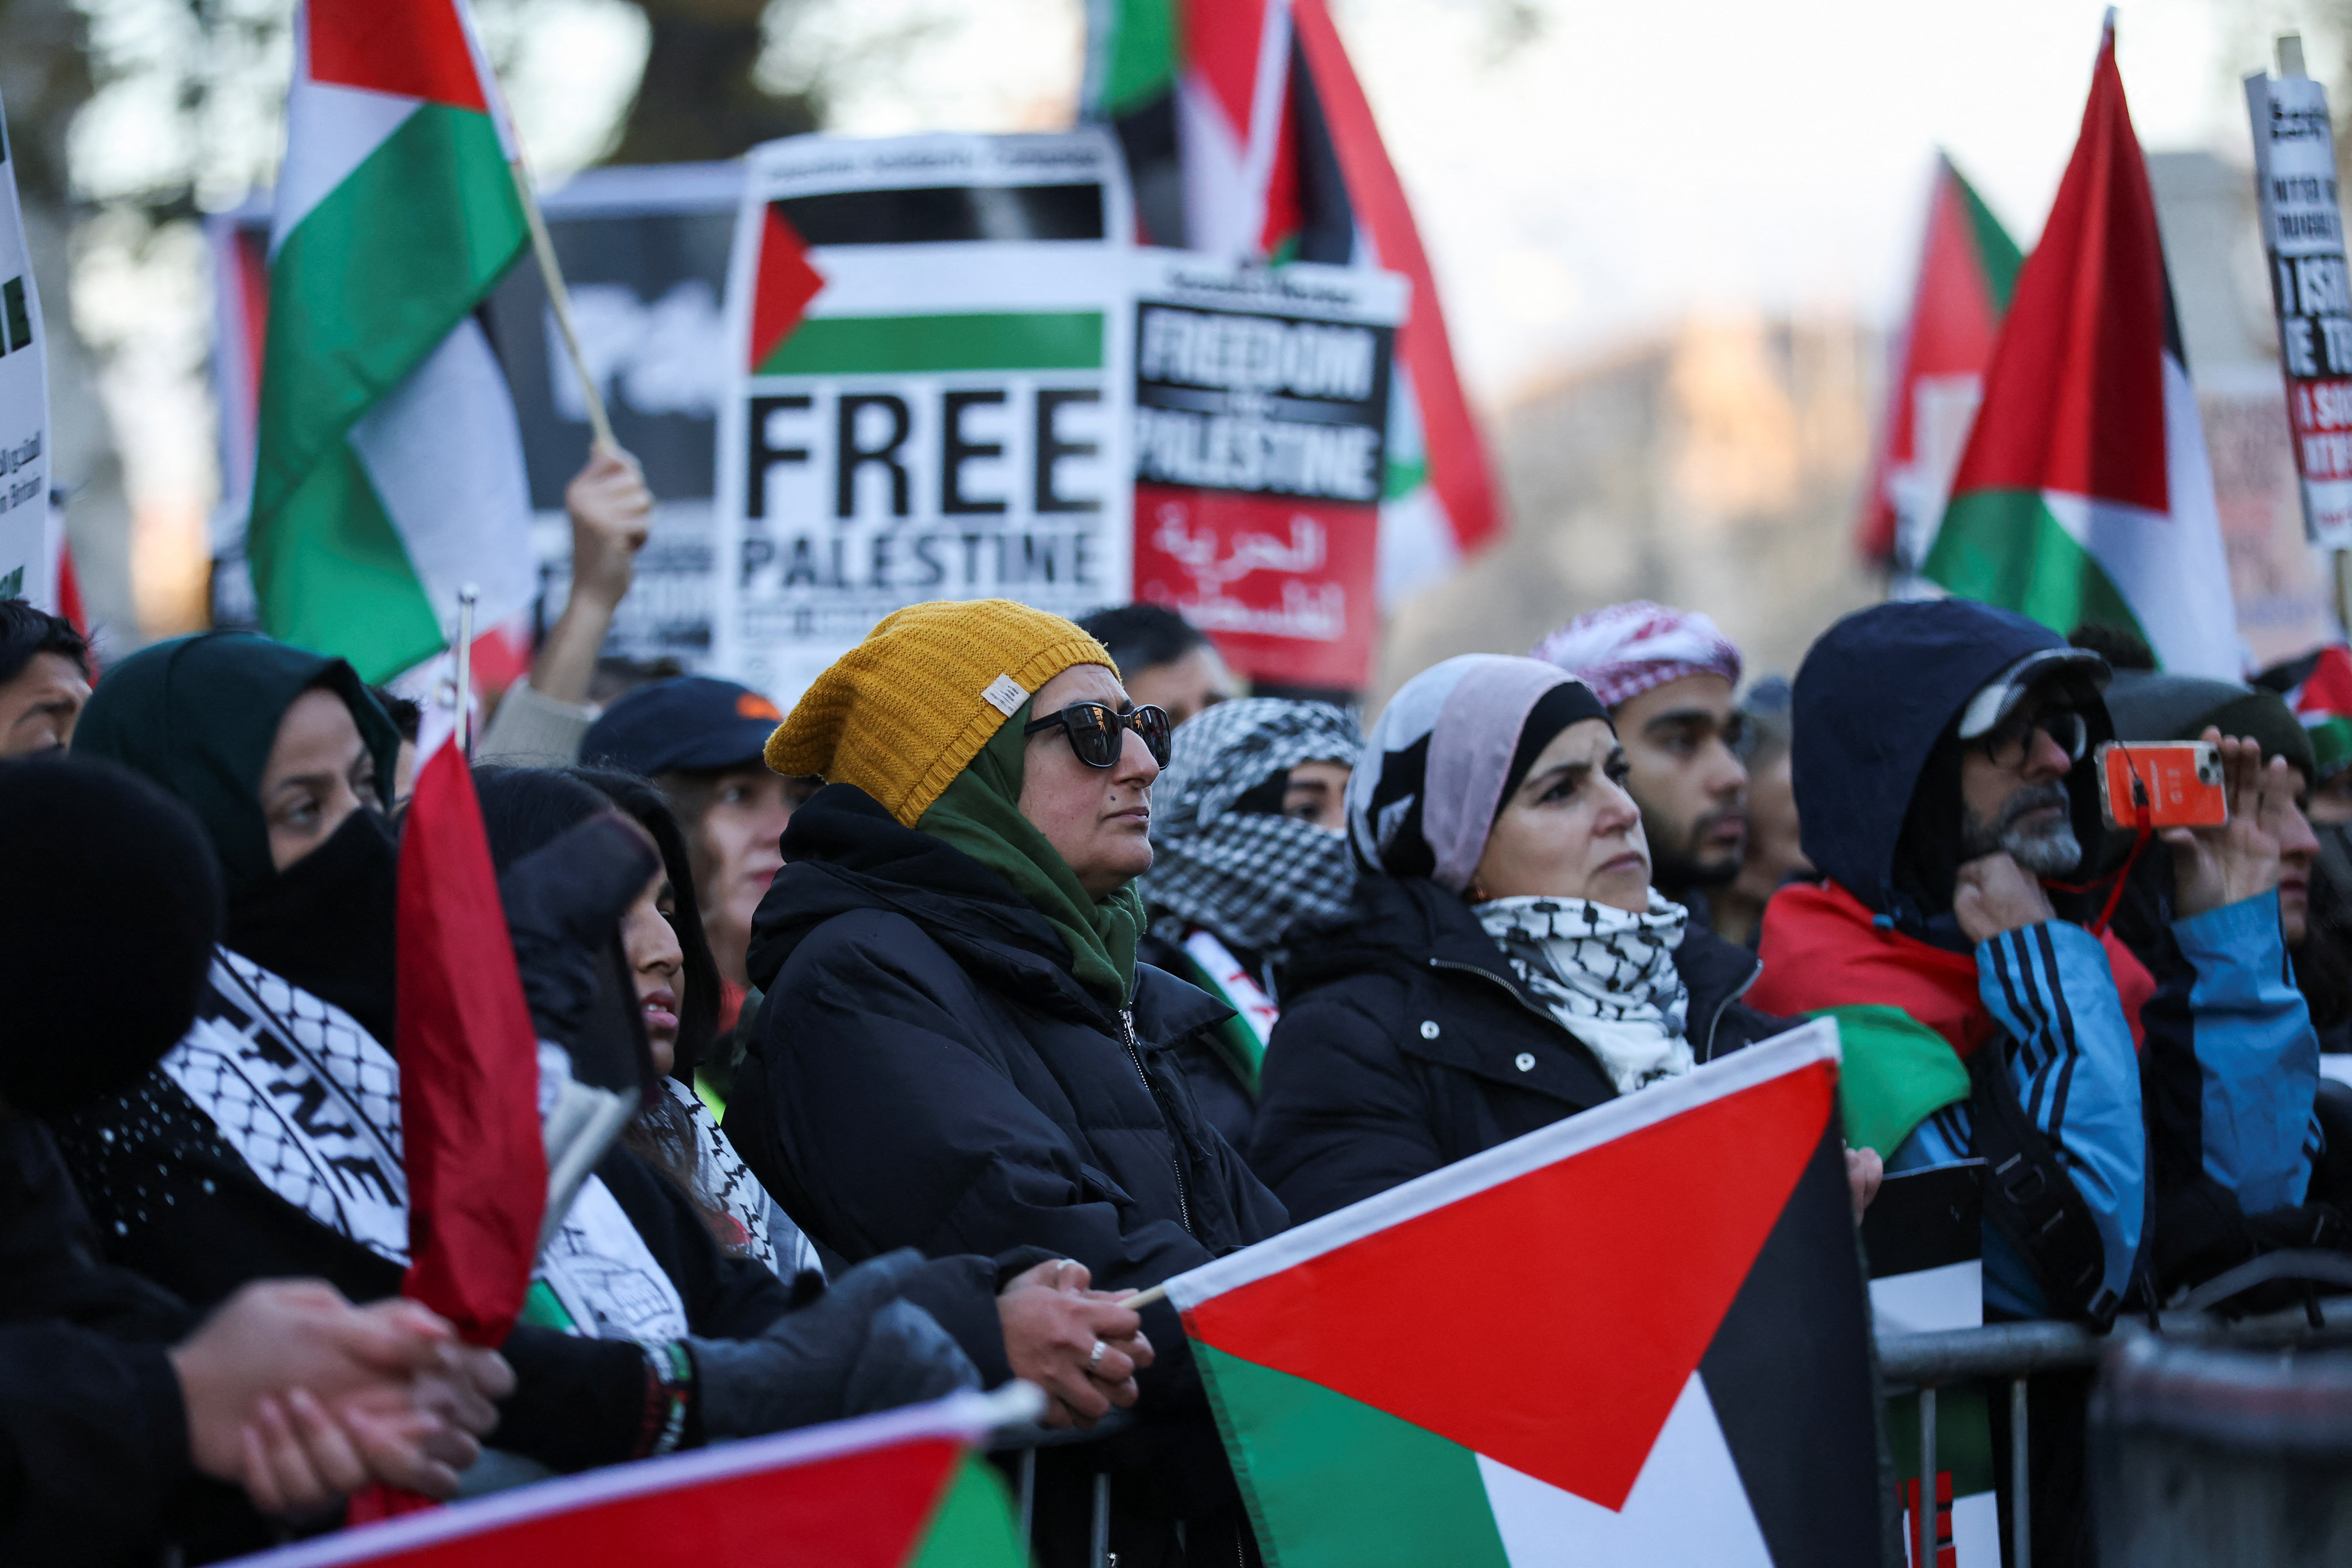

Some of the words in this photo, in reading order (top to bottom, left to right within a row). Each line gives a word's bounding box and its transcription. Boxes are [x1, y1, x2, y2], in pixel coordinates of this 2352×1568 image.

[1141, 308, 1376, 402] FREEDOM
[748, 389, 1102, 518] FREE
[1133, 407, 1380, 501] PALESTINE
[739, 533, 1100, 588] PALESTINE
